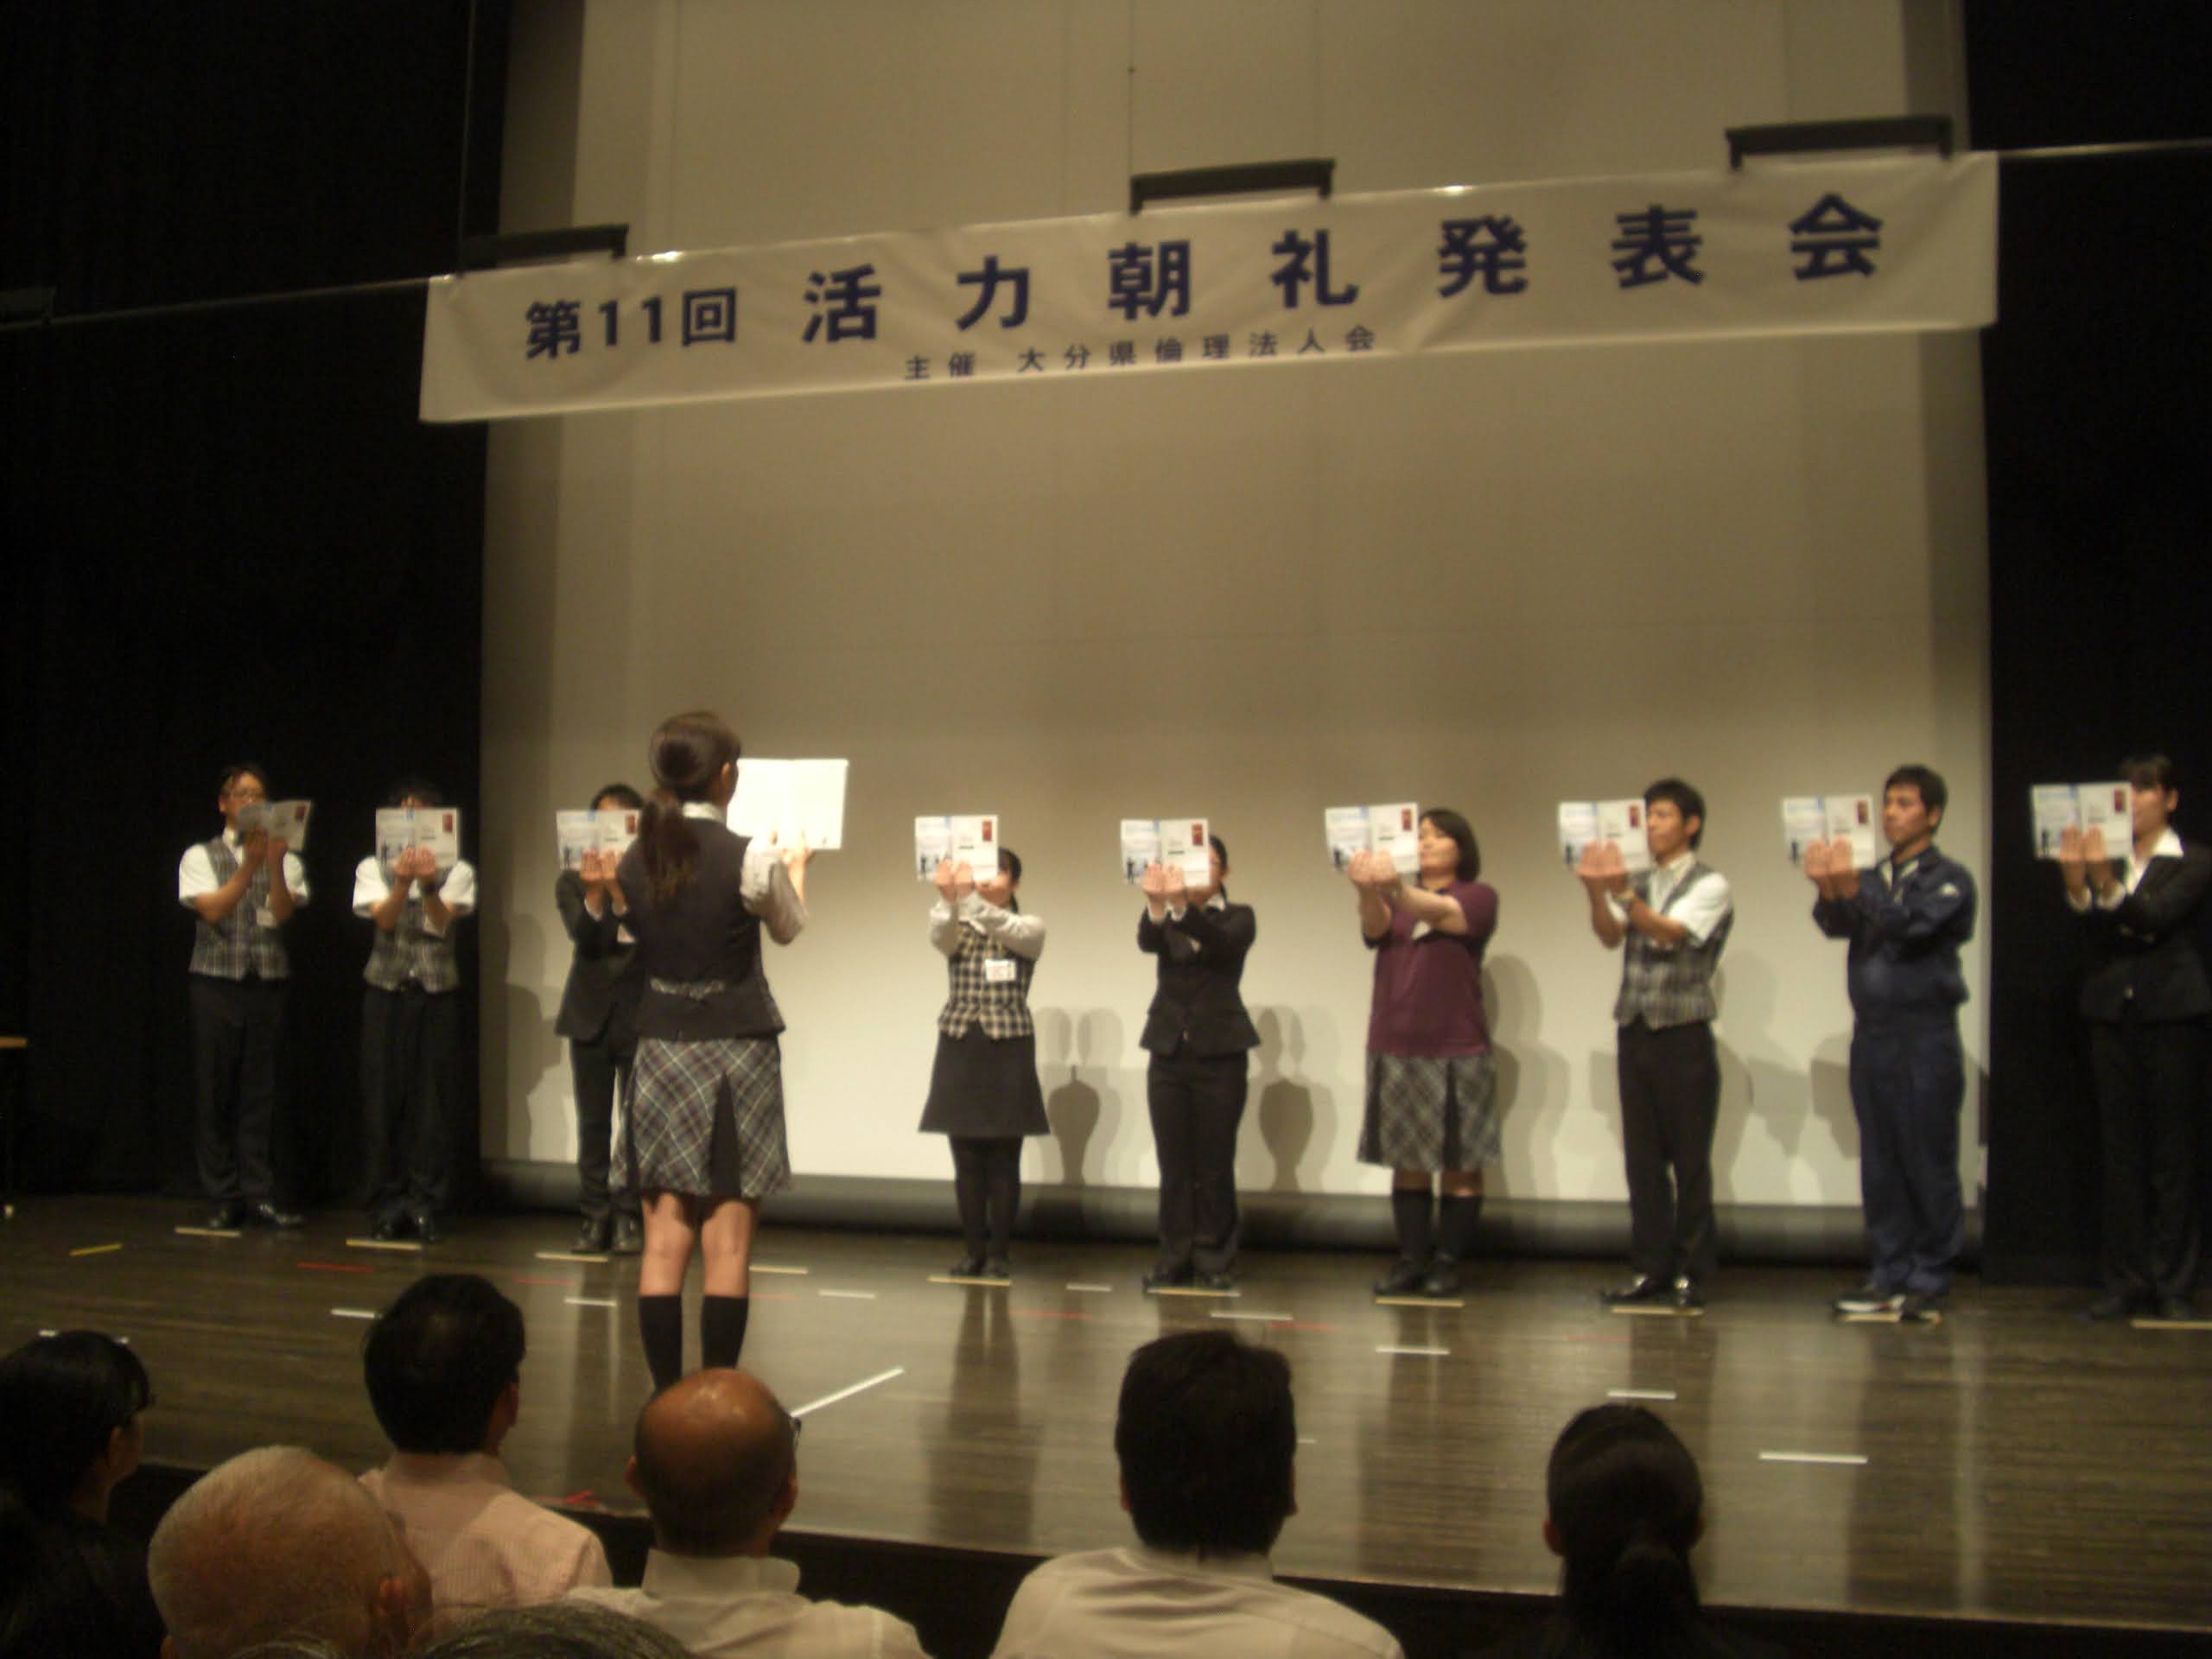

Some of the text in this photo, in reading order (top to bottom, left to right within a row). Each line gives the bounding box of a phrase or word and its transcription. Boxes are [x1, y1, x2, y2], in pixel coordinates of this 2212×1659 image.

[524, 193, 1884, 360] 第11回 活力朝礼発表会
[905, 324, 1376, 379] 主催 大分県倫理法人会
